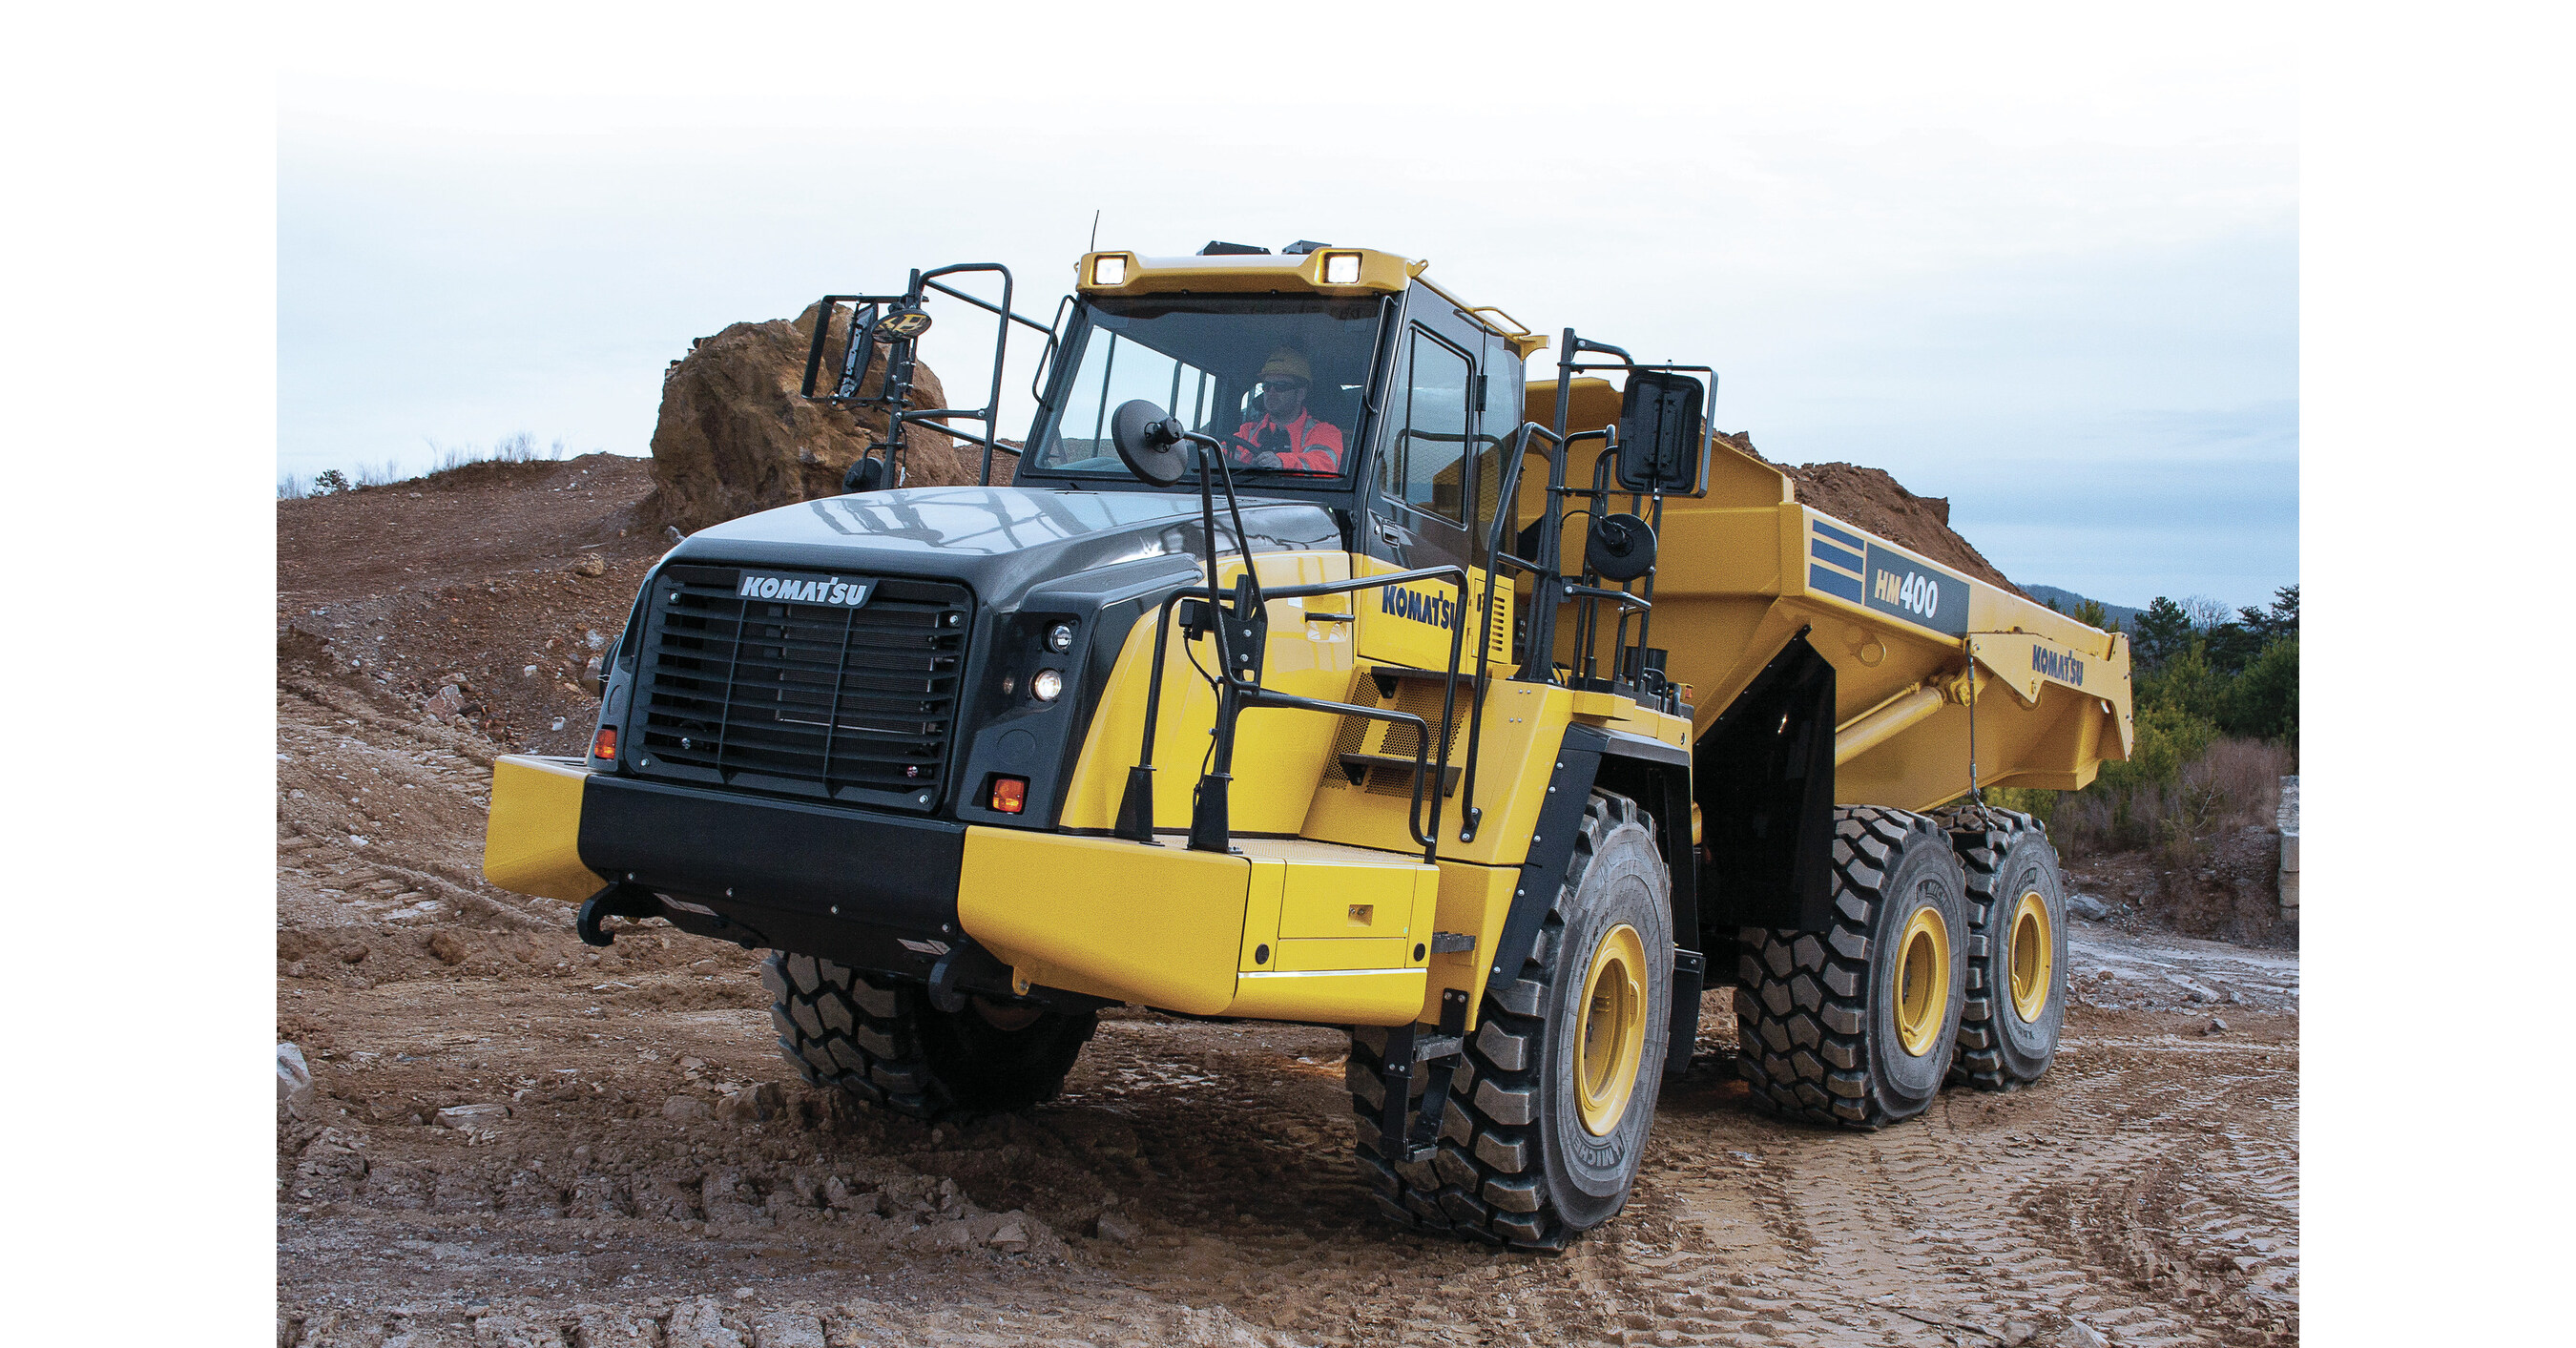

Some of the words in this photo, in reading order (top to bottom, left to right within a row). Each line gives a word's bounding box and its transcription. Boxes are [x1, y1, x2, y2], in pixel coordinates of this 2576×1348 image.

[740, 576, 867, 606] KOMATSU
[1874, 569, 1939, 619] HM400
[2031, 644, 2084, 687] KOMATSU
